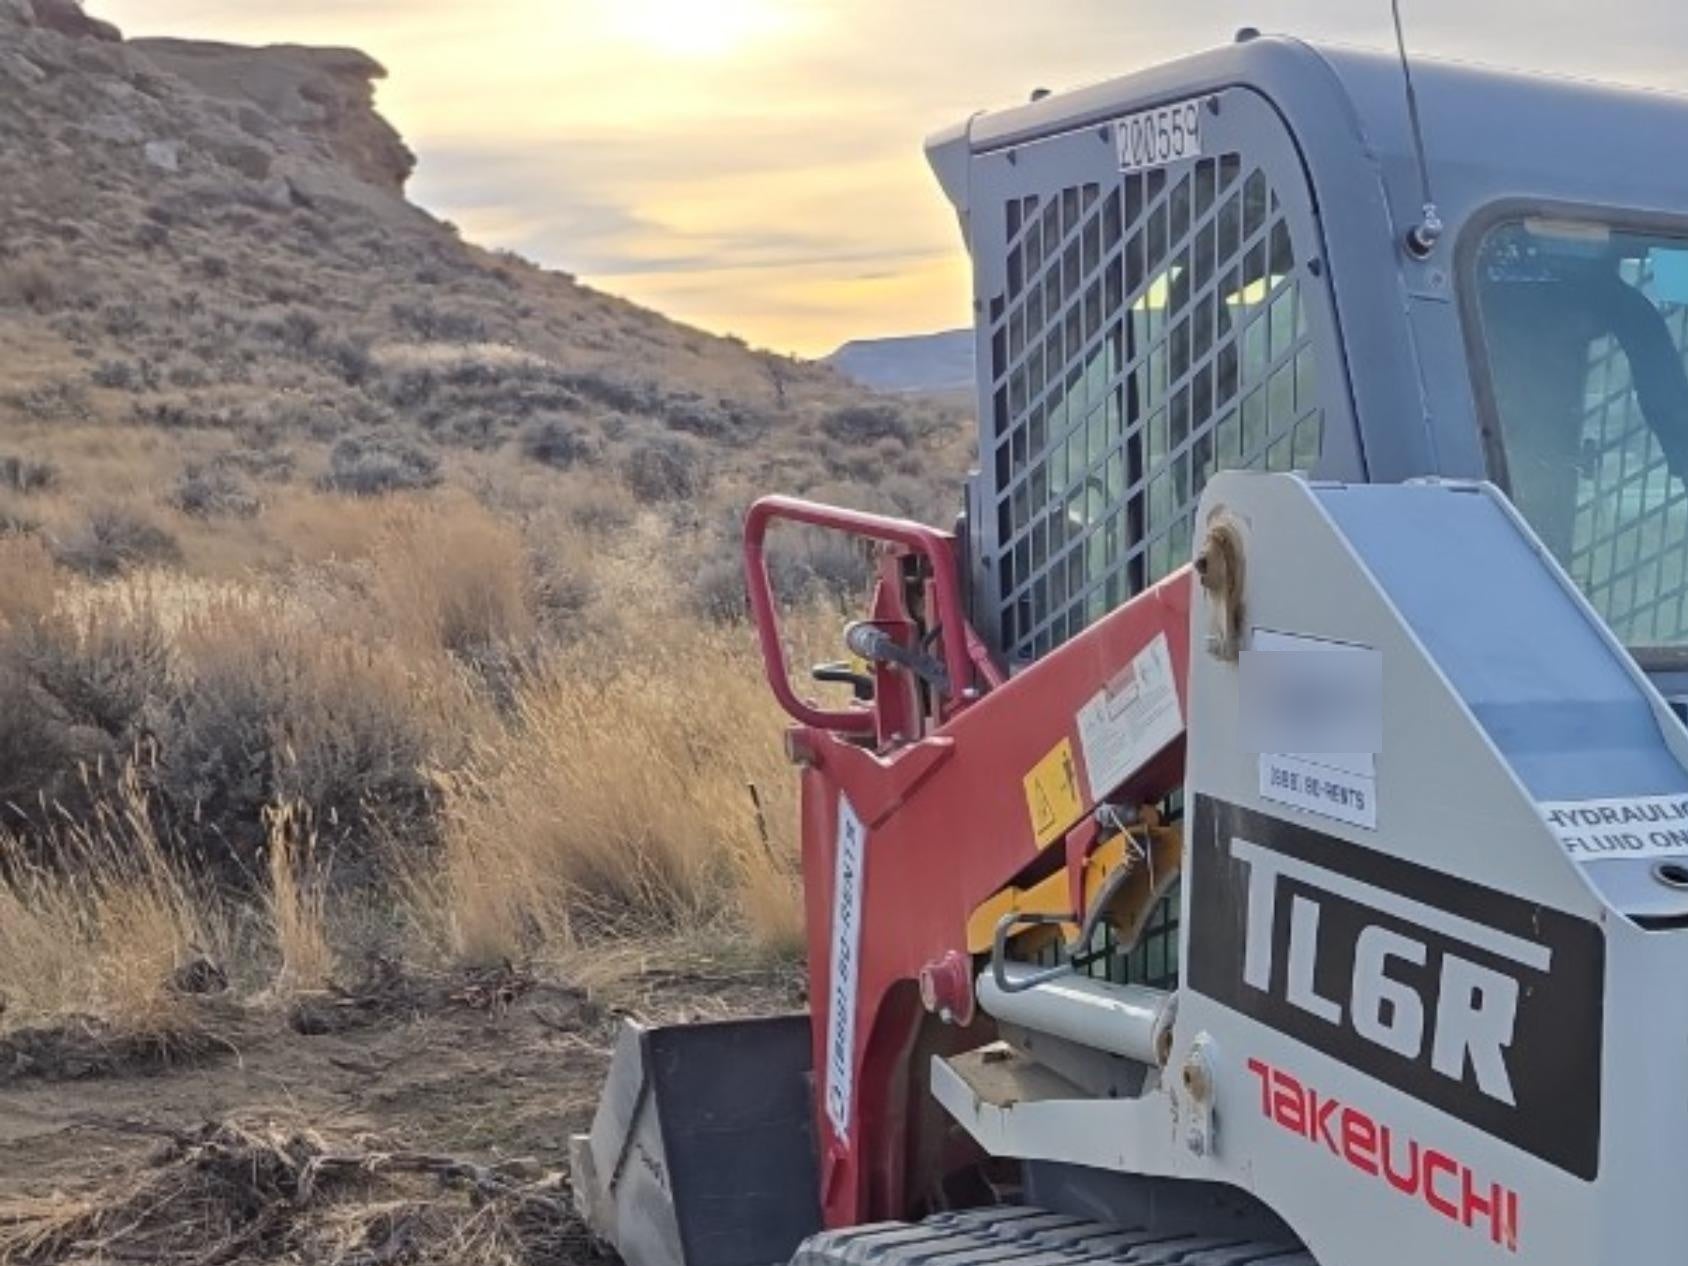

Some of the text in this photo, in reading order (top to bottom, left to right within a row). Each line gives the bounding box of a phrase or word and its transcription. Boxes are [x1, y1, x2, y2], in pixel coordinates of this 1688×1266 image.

[1119, 104, 1199, 168] 200559
[1562, 834, 1644, 853] FLUID
[1230, 837, 1553, 1107] TL6R
